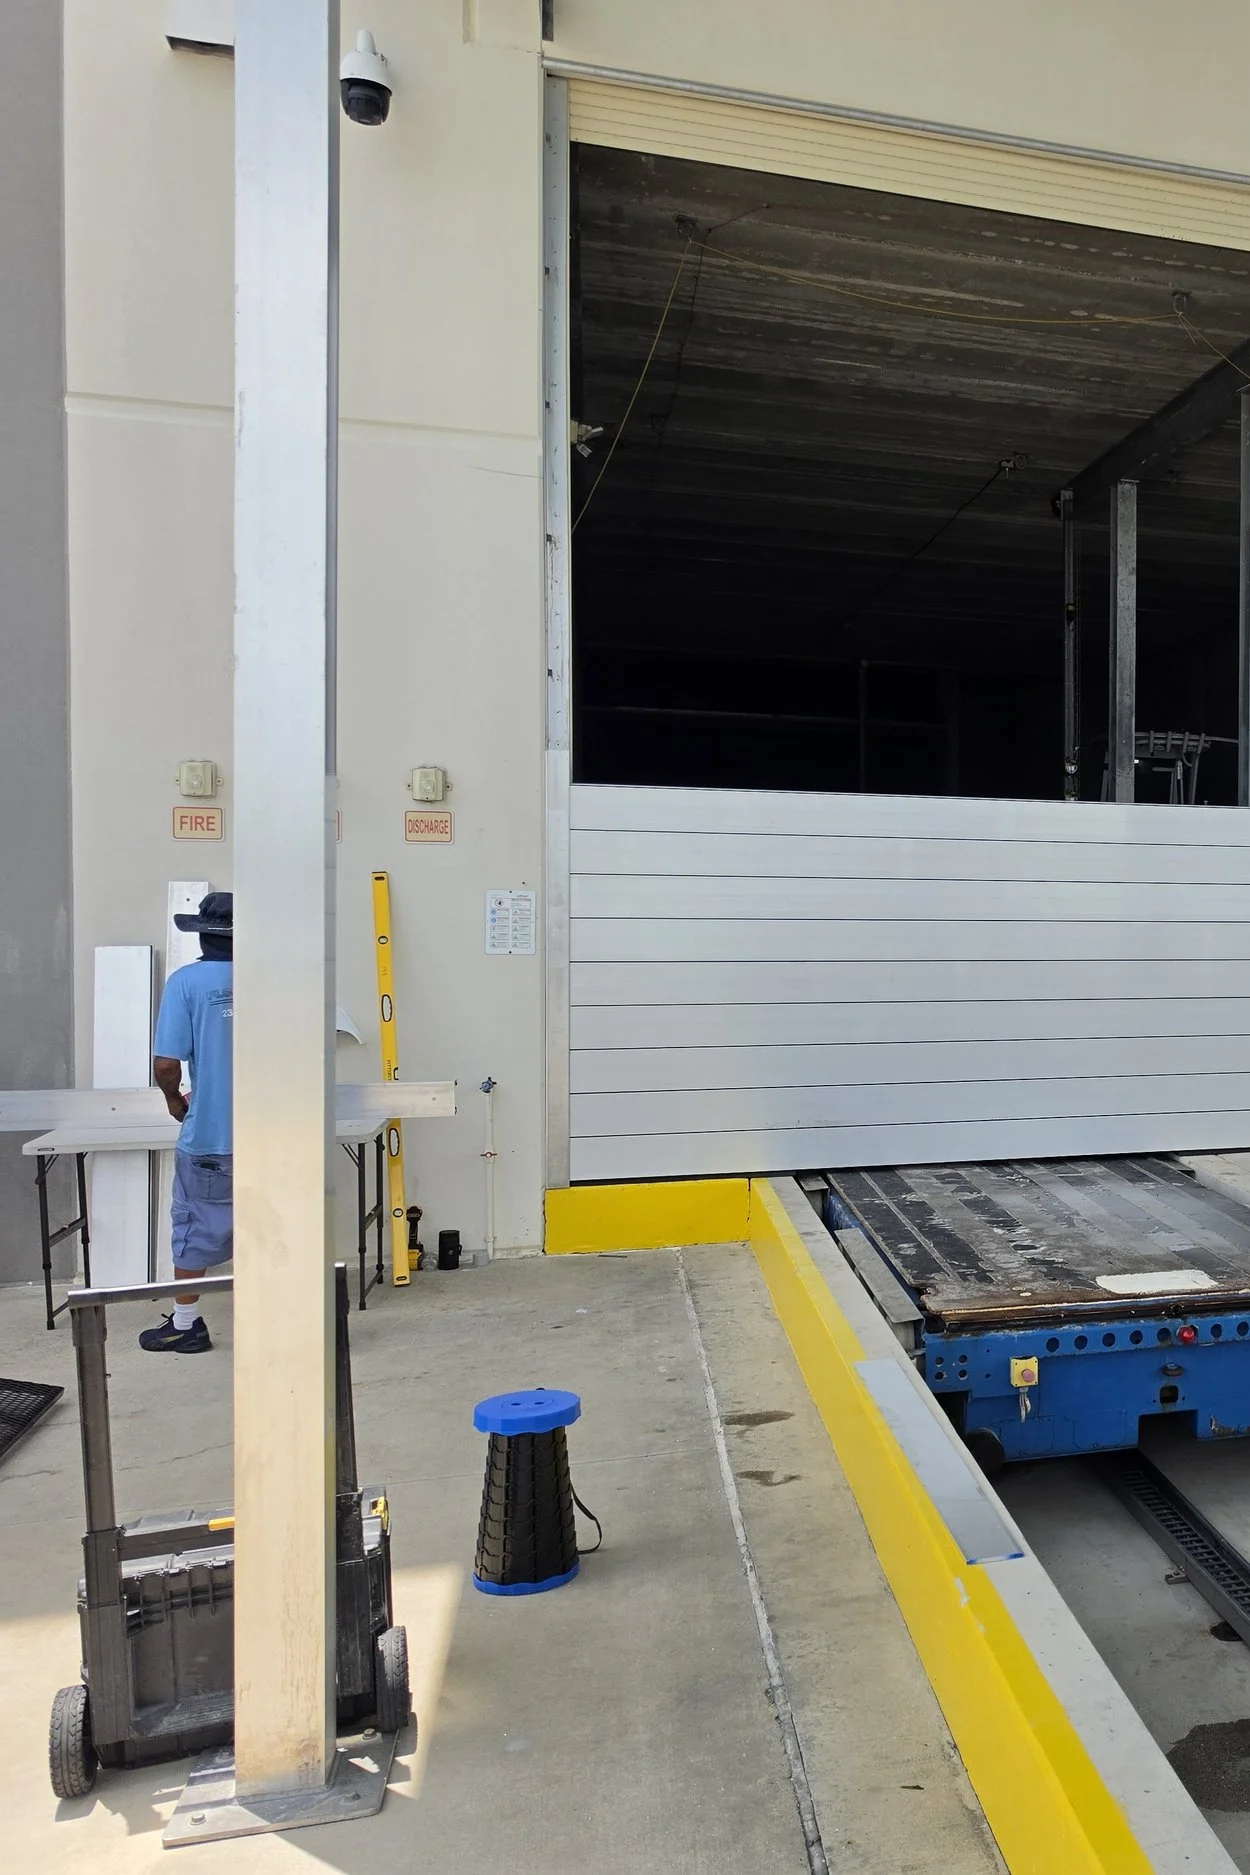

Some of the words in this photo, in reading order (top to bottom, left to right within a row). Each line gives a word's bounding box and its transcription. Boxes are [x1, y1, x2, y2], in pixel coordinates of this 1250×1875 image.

[180, 815, 216, 832] FIRE
[408, 819, 449, 834] DISCHARGE
[206, 987, 233, 1001] FLO
